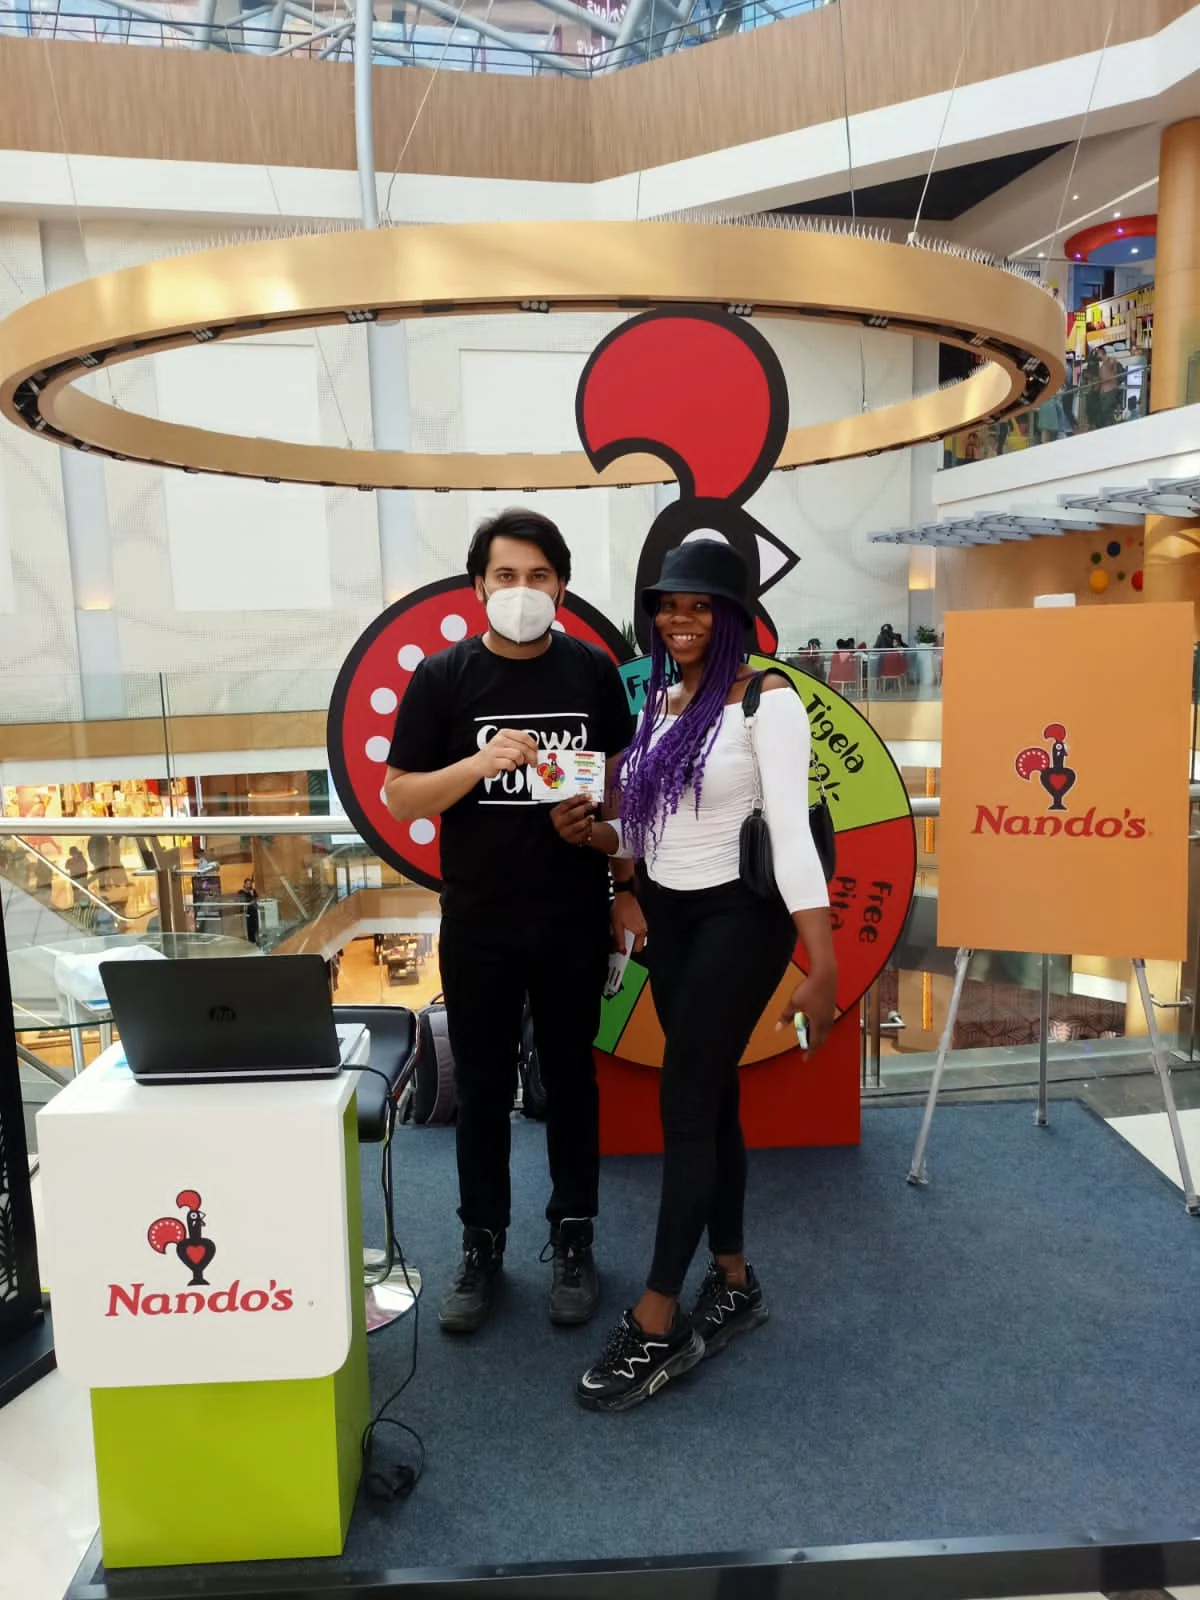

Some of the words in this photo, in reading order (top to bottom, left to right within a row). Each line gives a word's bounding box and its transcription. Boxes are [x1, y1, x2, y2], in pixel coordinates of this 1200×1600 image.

[806, 693, 864, 774] Tigela
[970, 805, 1146, 839] Nando's
[858, 881, 892, 944] Free
[105, 1279, 294, 1317] Nando's
